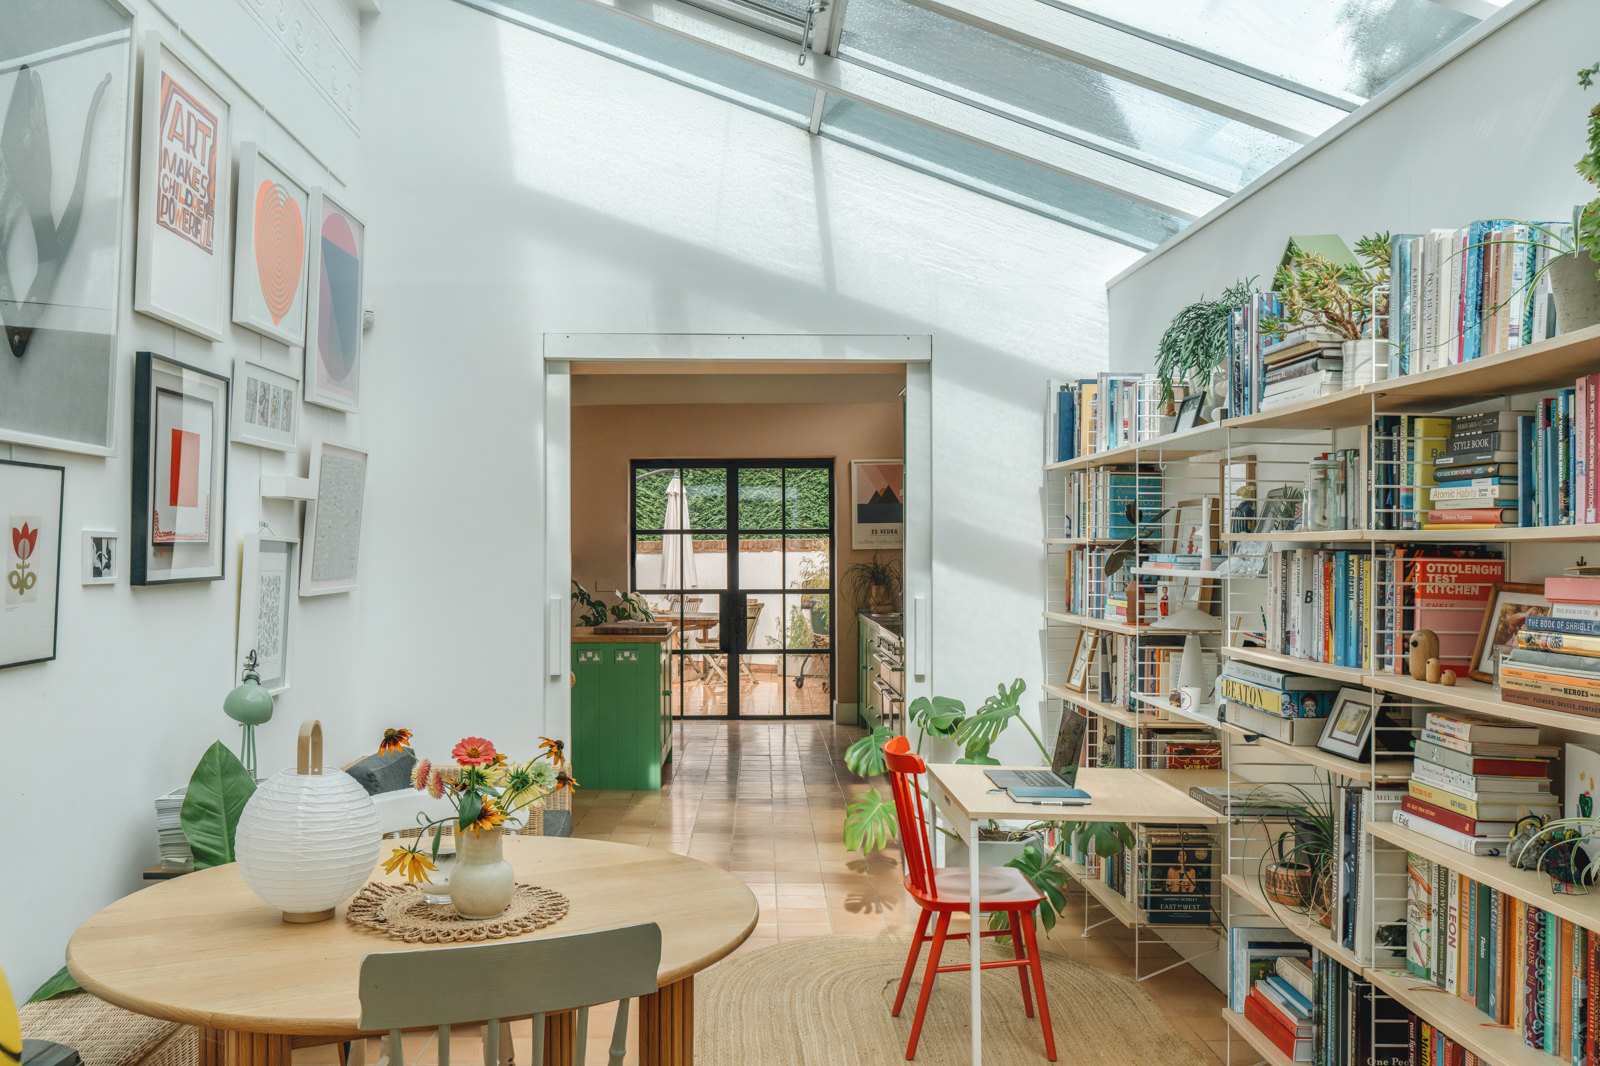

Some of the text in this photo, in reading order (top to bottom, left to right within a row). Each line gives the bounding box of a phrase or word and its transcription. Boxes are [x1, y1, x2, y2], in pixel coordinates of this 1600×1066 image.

[167, 99, 212, 167] ART
[162, 146, 208, 200] MAKES
[161, 173, 211, 220] CHILDREN
[160, 193, 212, 248] POWERFUL
[1451, 236, 1460, 297] DECORATE
[1453, 437, 1489, 451] STYLE BOOK
[1432, 487, 1477, 499] Atomic Habits
[1116, 495, 1154, 506] Meico
[1426, 562, 1502, 575] OTTOLENGHI
[1426, 573, 1458, 583] TEST
[1426, 584, 1480, 595] KITCHEN
[1528, 618, 1539, 626] THE
[1540, 619, 1555, 628] BOOK
[1565, 621, 1595, 631] SHRIGLEY
[1225, 679, 1263, 707] BEATON
[1563, 687, 1589, 697] HEROES
[1533, 697, 1556, 706] FLOWERS,
[1557, 701, 1577, 710] SKULLS,
[1446, 724, 1456, 732] Theory
[1439, 865, 1447, 898] lentine
[1448, 905, 1457, 949] LEON
[1527, 920, 1536, 966] ISLANDS
[1546, 965, 1553, 981] 5
[1408, 1039, 1416, 1051] figs
[1366, 1057, 1389, 1066] One
